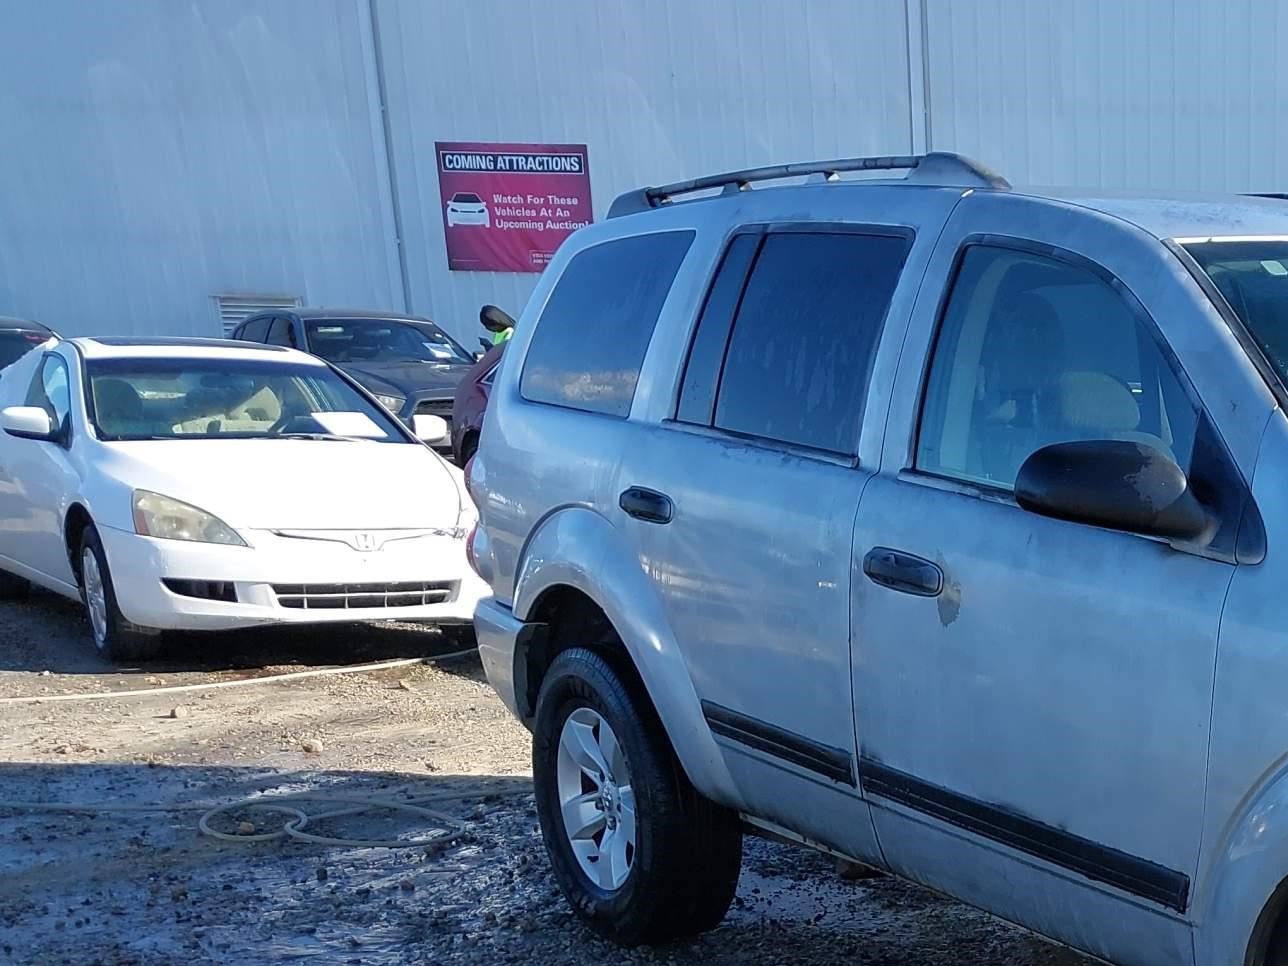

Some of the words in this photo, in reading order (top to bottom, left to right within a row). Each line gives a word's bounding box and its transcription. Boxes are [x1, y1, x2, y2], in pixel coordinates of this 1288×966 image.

[445, 155, 494, 170] COMING
[496, 156, 580, 171] ATTRACTIONS
[493, 193, 524, 205] Watch
[527, 194, 545, 205] For
[547, 195, 578, 206] These
[494, 206, 537, 217] Vehicles
[539, 207, 553, 217] At
[555, 208, 570, 218] An
[495, 219, 544, 231] Upcoming
